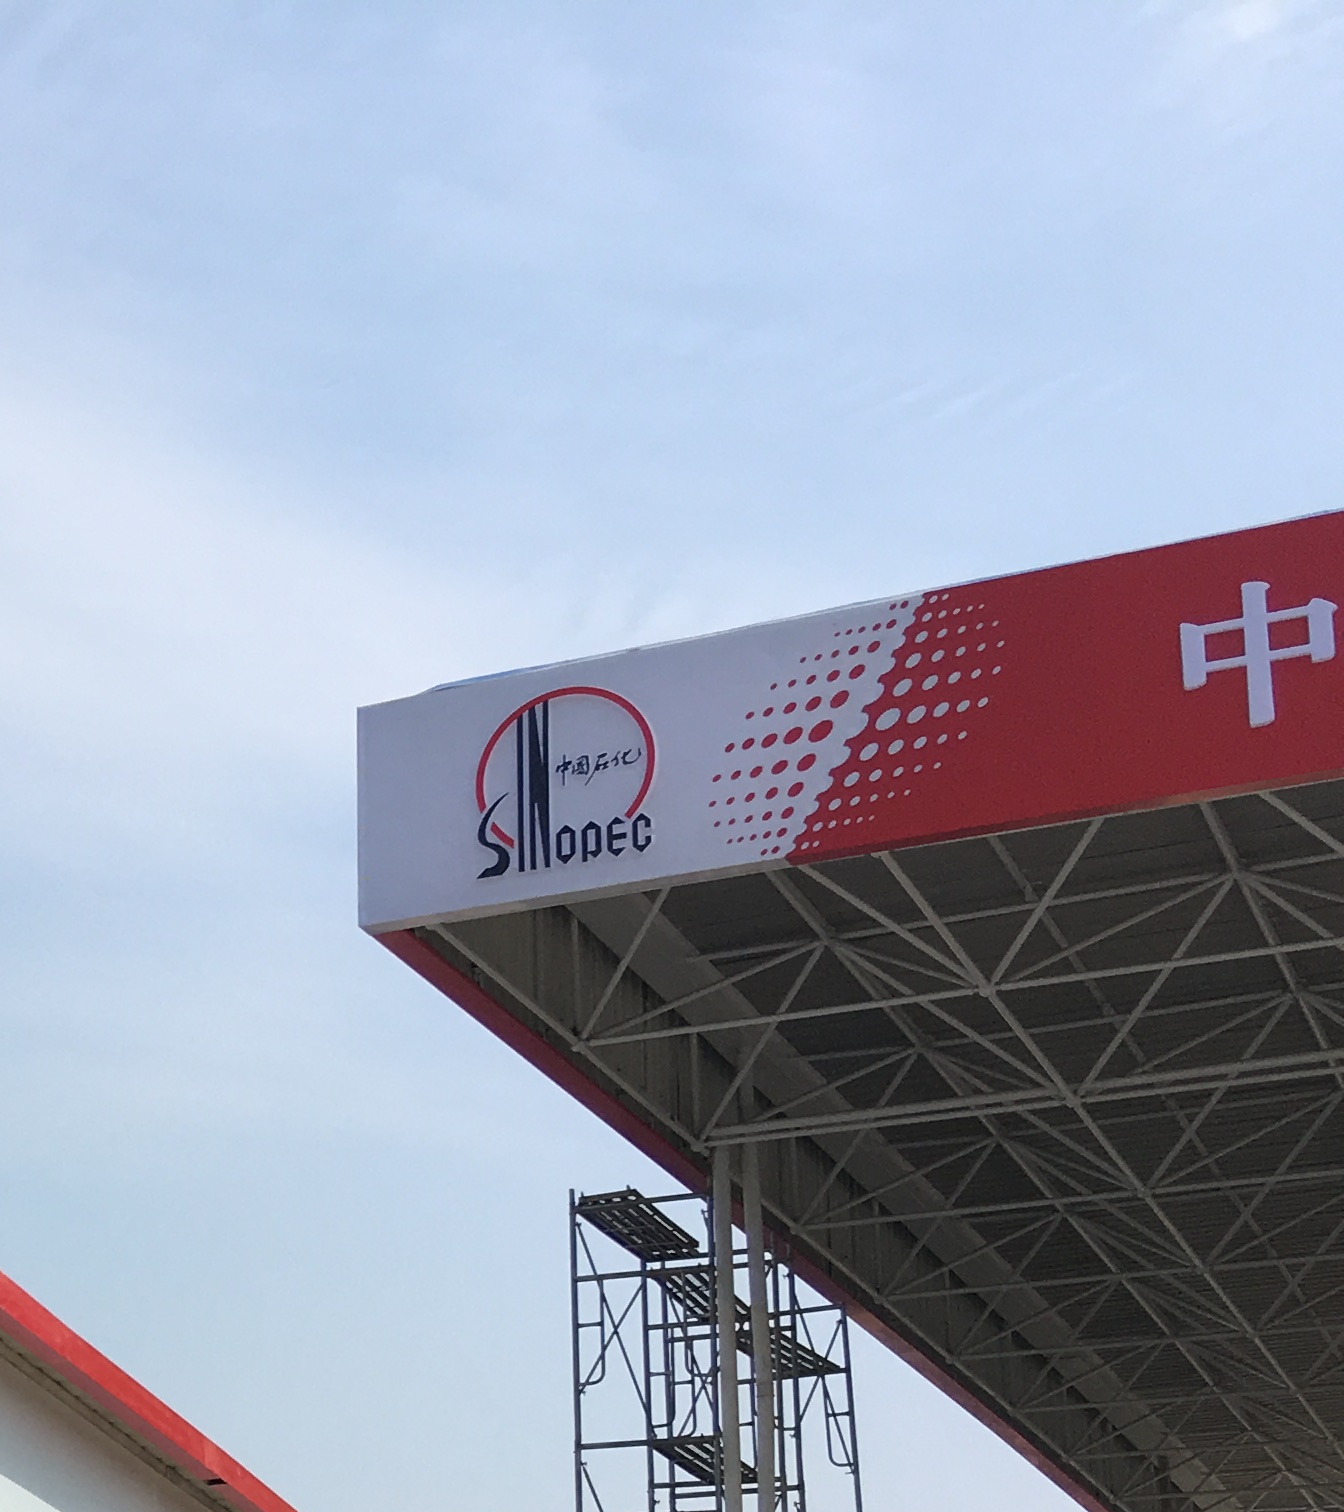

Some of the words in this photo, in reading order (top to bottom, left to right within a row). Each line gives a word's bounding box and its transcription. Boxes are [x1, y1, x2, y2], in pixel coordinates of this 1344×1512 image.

[1179, 580, 1339, 726] 中
[476, 699, 653, 880] SINOPEC
[555, 747, 642, 787] 中国石化
